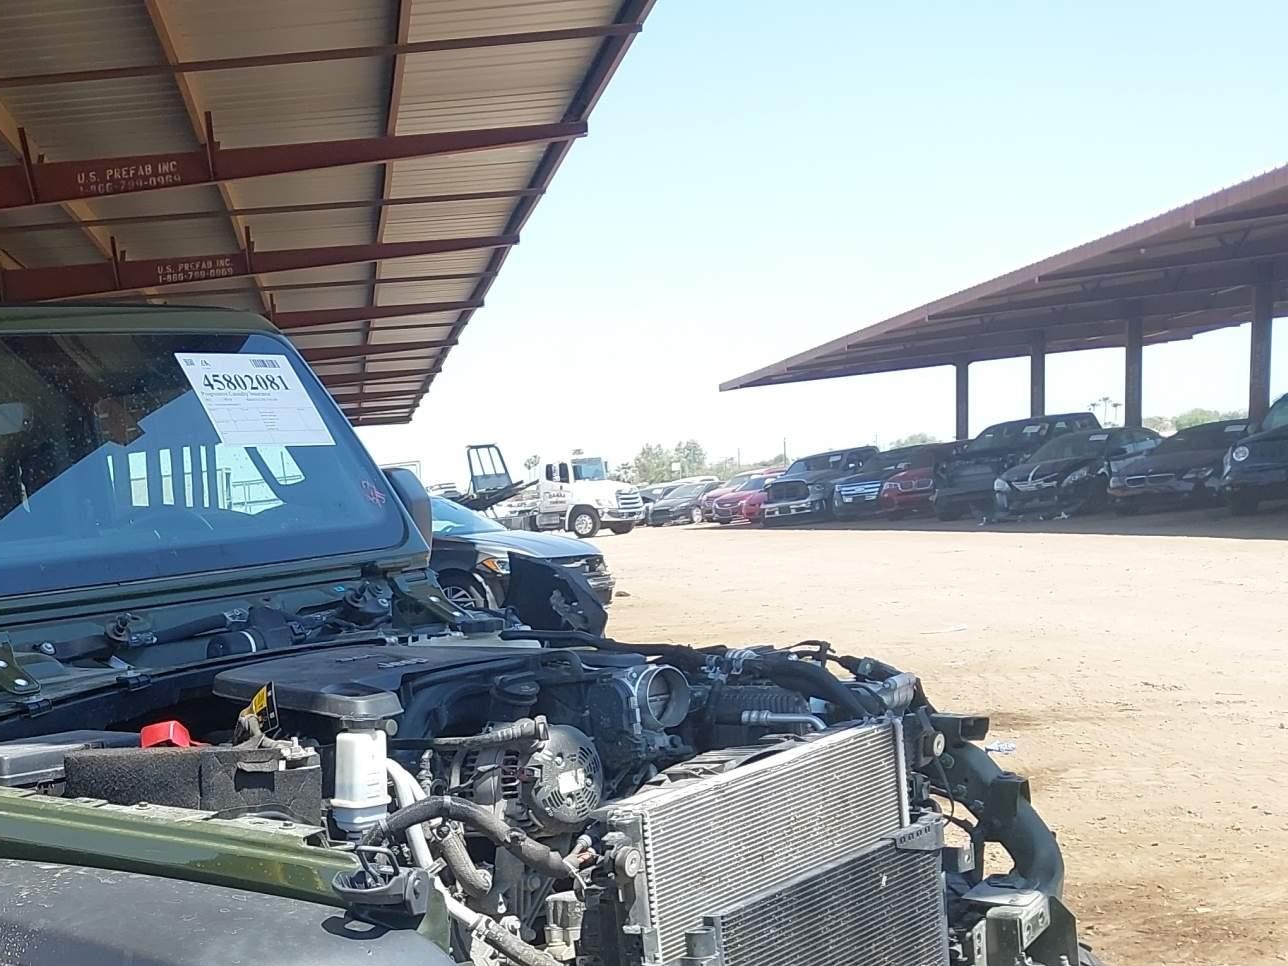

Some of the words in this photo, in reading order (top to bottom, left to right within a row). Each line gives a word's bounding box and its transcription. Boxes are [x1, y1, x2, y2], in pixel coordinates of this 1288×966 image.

[77, 171, 100, 184] U.S.
[106, 163, 152, 180] PREFAB
[202, 373, 291, 391] 45802081
